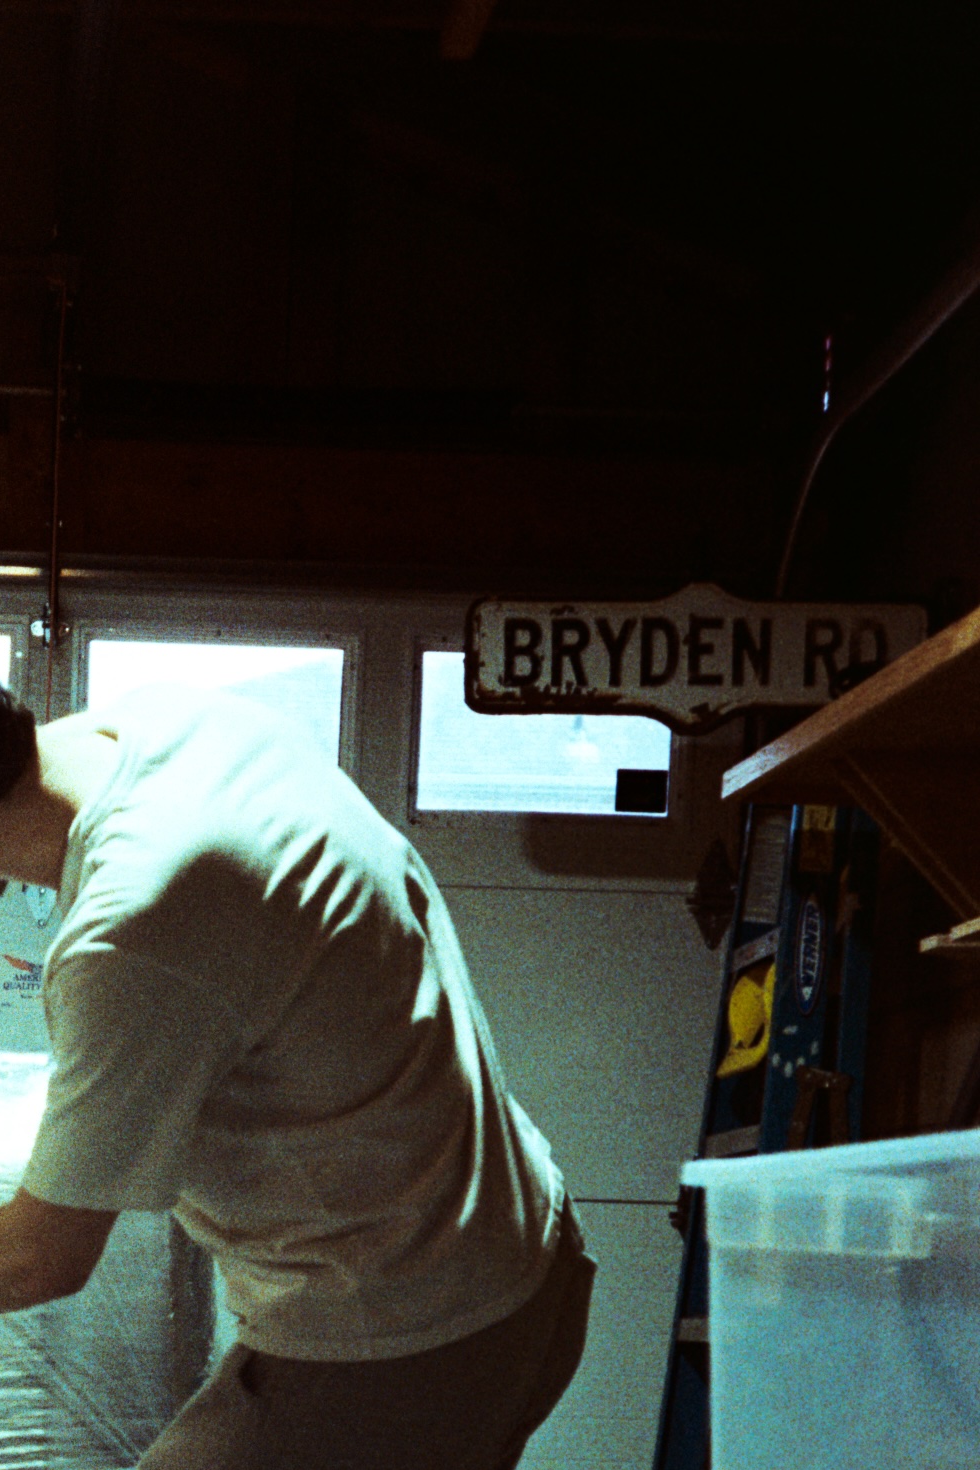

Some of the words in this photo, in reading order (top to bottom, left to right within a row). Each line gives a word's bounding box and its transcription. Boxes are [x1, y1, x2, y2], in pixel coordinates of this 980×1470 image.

[504, 615, 773, 688] BRYDEN
[804, 617, 889, 688] RD
[801, 903, 819, 989] WERNER
